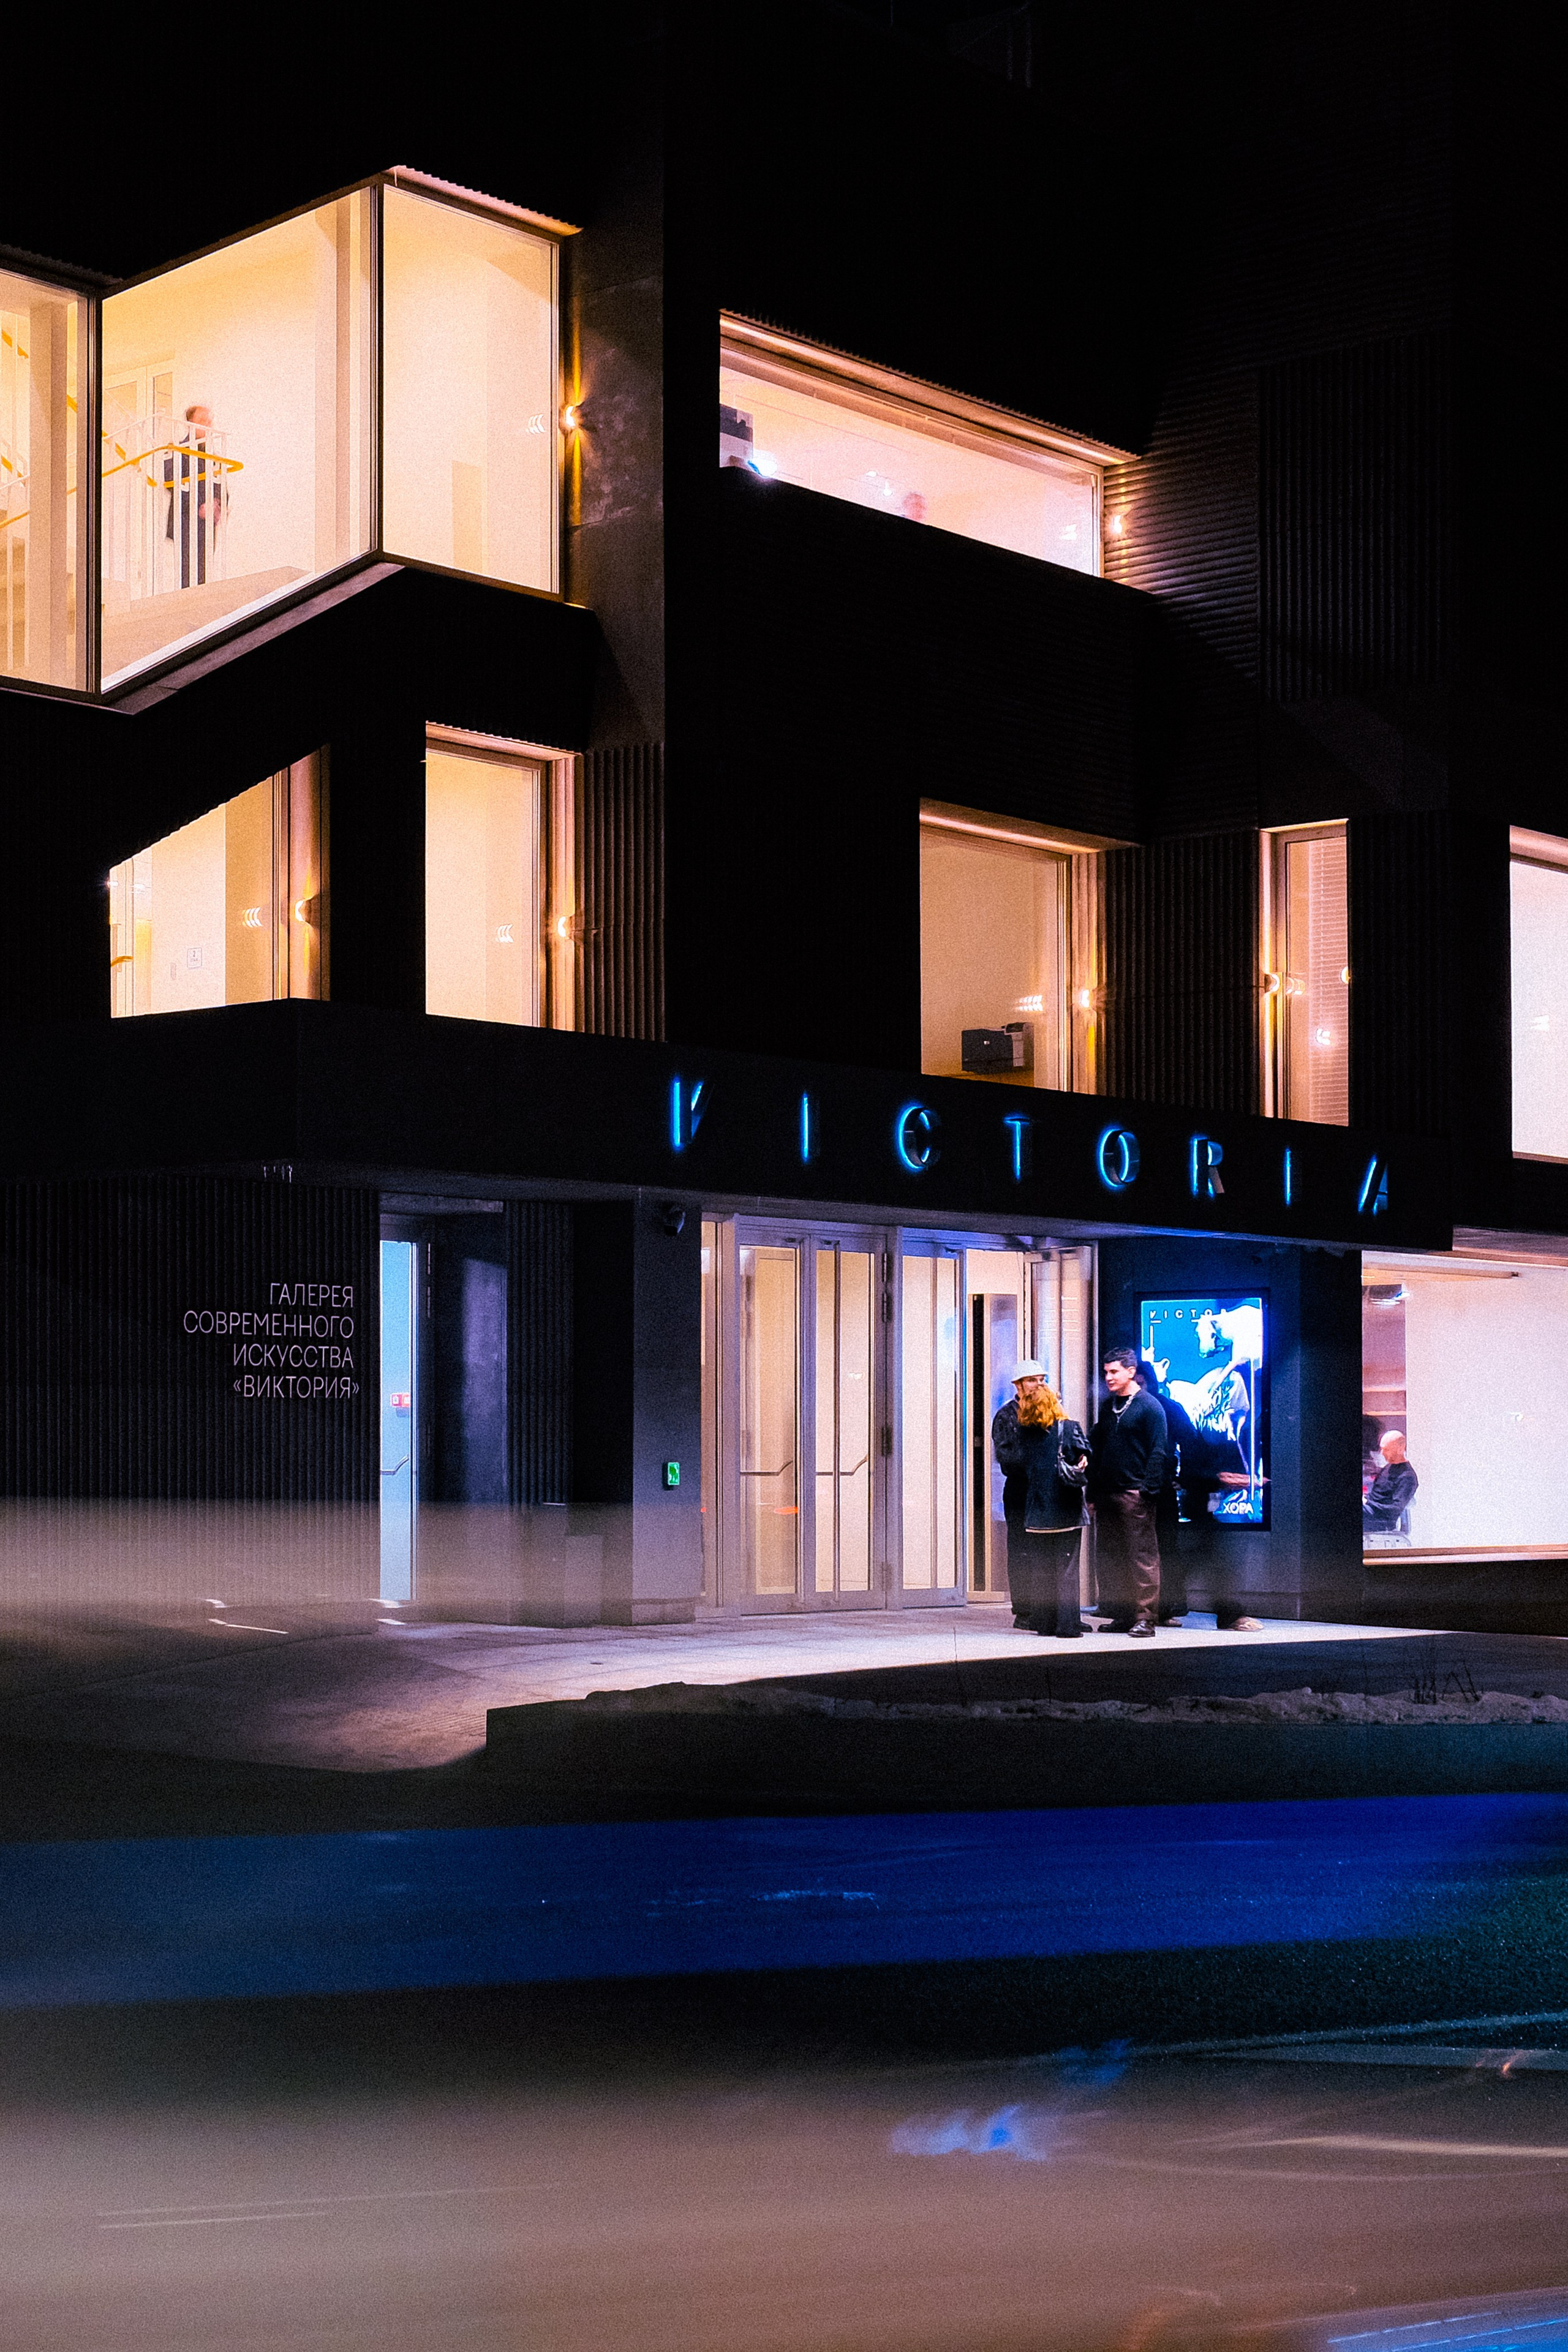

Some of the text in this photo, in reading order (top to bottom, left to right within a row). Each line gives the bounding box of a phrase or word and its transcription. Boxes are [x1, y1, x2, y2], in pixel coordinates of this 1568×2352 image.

[671, 1076, 1389, 1213] VICTORIA
[270, 1283, 353, 1308] ГАЛЕРЕЯ
[183, 1310, 354, 1339] СОВРЕМЕННОГО
[233, 1343, 354, 1368] ИСКУССТВА
[233, 1374, 360, 1399] «ВИКТОРИЯ»
